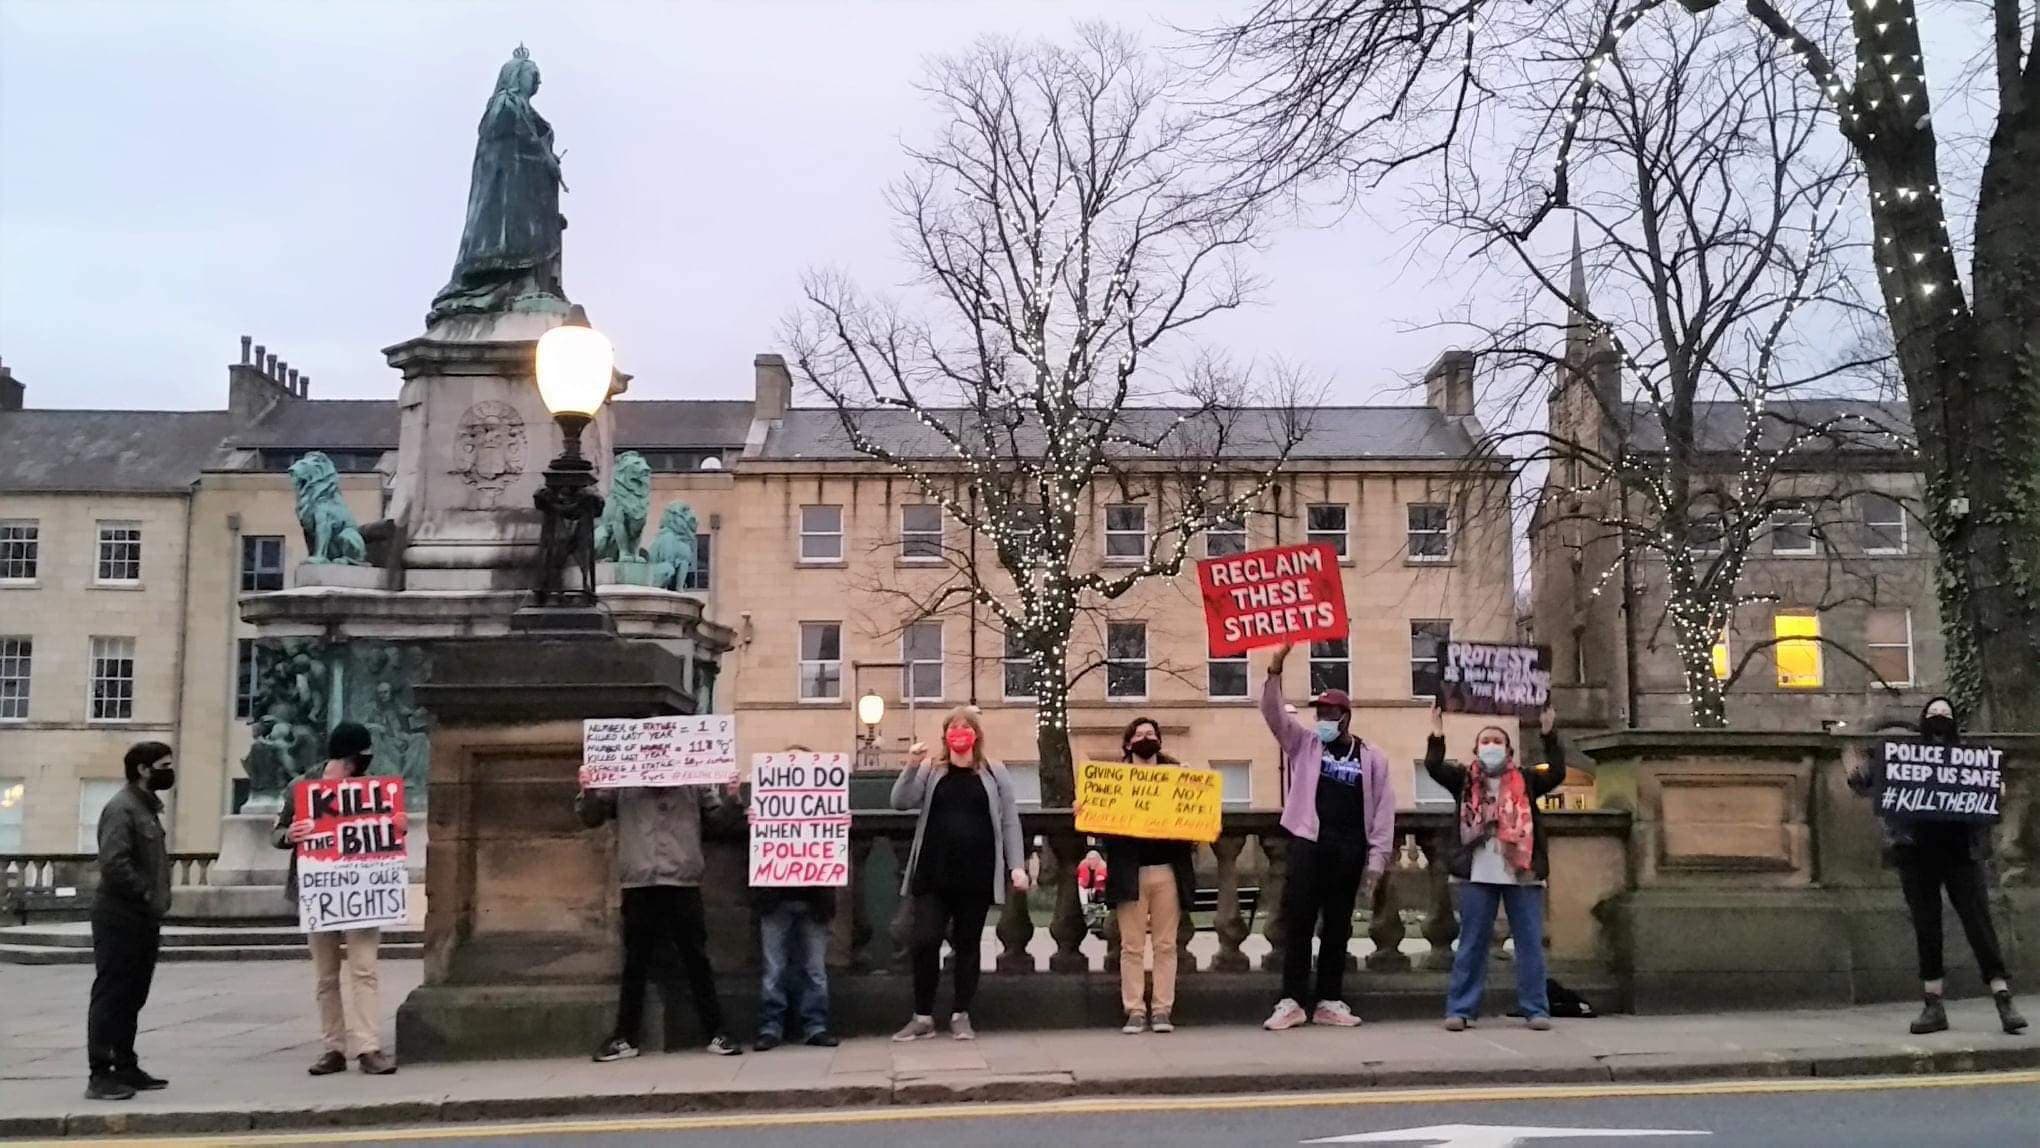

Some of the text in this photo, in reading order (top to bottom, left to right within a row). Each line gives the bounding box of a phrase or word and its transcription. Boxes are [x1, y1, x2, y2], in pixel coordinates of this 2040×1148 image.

[1210, 547, 1323, 587] RECLAIM
[1229, 577, 1314, 610] THESE
[1223, 601, 1335, 642] STREETS
[1447, 643, 1539, 669] PROTEST
[1494, 681, 1548, 706] WORLD
[621, 731, 645, 741] LAST
[649, 730, 675, 741] YEAR
[697, 721, 710, 732] 1
[621, 752, 640, 762] LAST
[644, 750, 671, 760] YEAR
[1884, 741, 2003, 769] POLICE DON'T
[758, 766, 845, 787] WHO DO
[1084, 764, 1215, 787] GIVING POLICE MORE
[1886, 763, 2001, 788] KEEP US SAFE
[308, 784, 393, 819] KILL
[1084, 781, 1204, 800] POWER WILL NOT
[1881, 785, 1999, 815] #KILLTHEBILL
[754, 794, 847, 817] YOU CALL
[1082, 795, 1117, 809] KEEP
[1134, 799, 1151, 812] US
[304, 823, 402, 854] THE BILL
[755, 822, 848, 838] WHEN THE
[762, 841, 834, 859] POLICE
[303, 870, 402, 888] DEFEND OUR
[754, 859, 846, 882] MURDER
[319, 888, 406, 920] RIGHTS!
